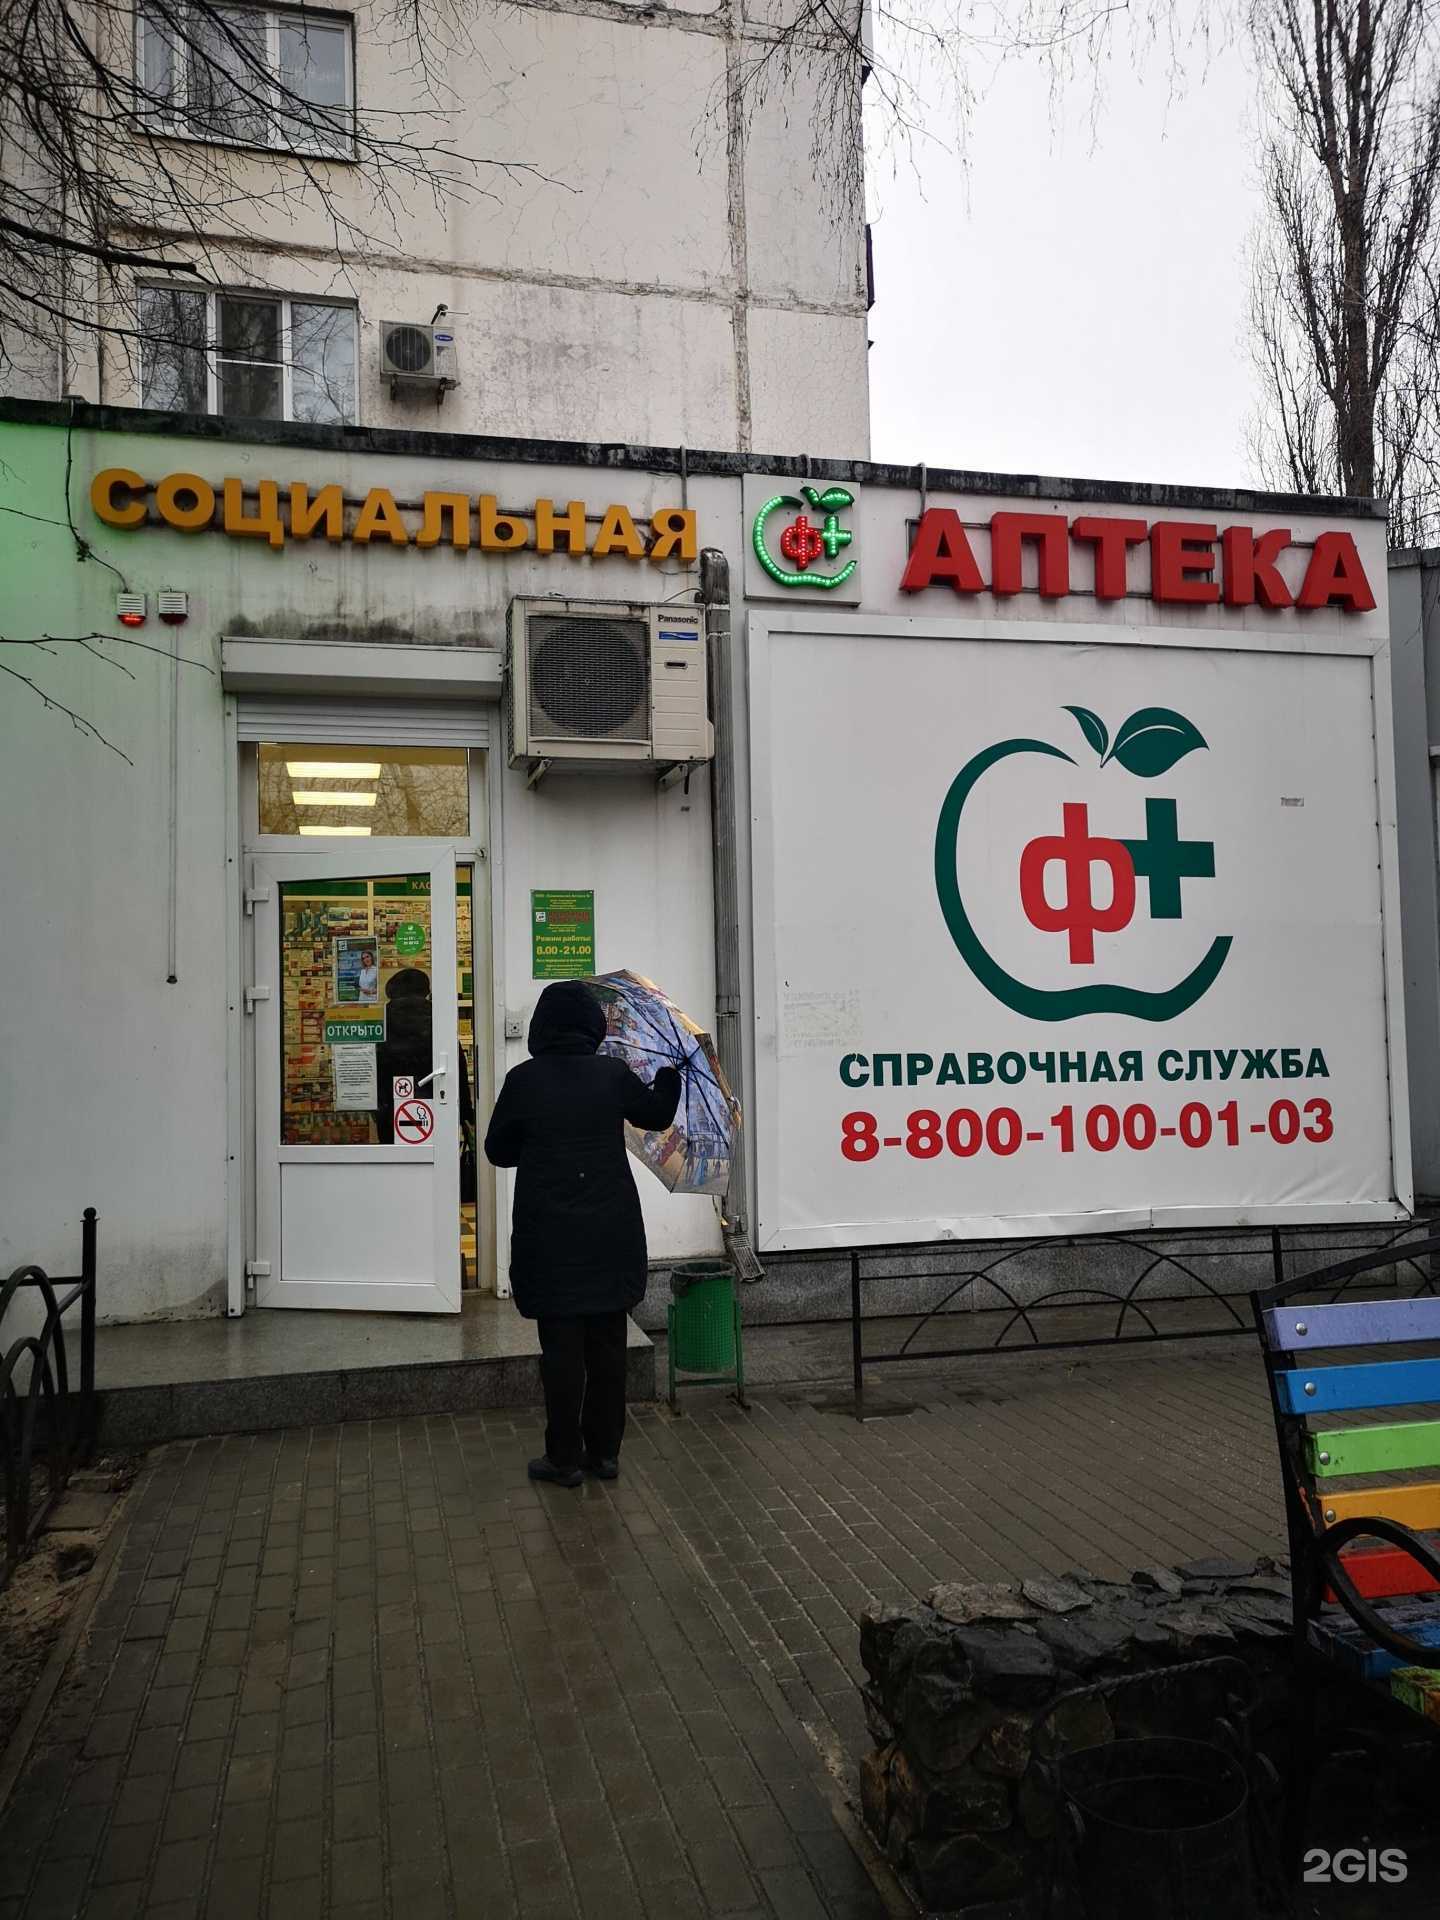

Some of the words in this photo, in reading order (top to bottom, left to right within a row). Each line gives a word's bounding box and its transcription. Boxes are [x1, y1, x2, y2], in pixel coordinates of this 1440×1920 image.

[90, 467, 697, 562] СОЦИАЛЬНАЯ
[899, 507, 1377, 612] АПТЕКА
[657, 614, 699, 624] Panasonic
[327, 1025, 383, 1037] ОТКРЫТО
[839, 1049, 1143, 1088] СПРАВОЧНАЯ
[1158, 1047, 1330, 1081] СЛУЖБА
[840, 1096, 1335, 1162] 8-800-100-01-03
